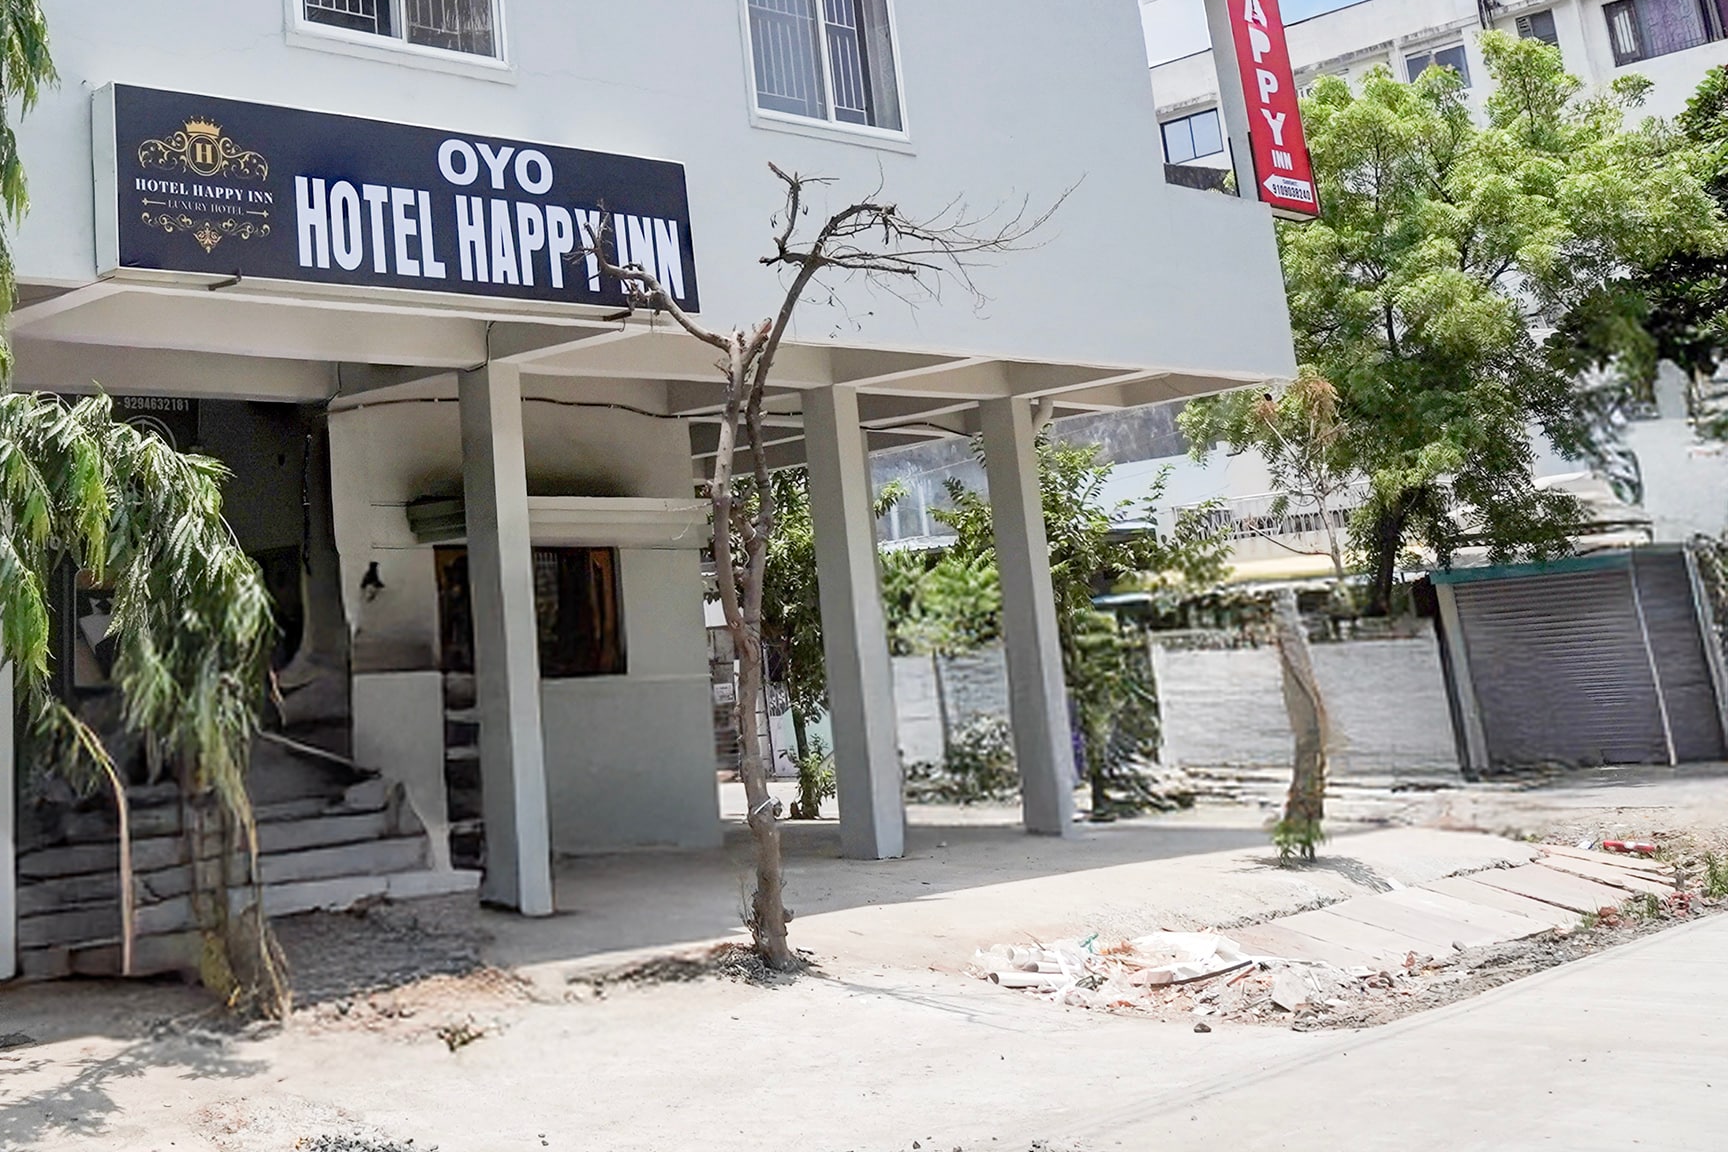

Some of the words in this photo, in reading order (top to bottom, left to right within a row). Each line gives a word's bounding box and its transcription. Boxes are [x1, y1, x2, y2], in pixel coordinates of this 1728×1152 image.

[195, 142, 214, 165] H
[1271, 149, 1294, 171] INN
[436, 138, 554, 195] OYO
[135, 178, 189, 196] HOTEL
[193, 184, 244, 202] HAPPY
[248, 190, 274, 205] INN
[167, 199, 208, 213] LUXURY
[210, 203, 245, 216] HOTEL
[295, 175, 447, 280] HOTEL
[455, 194, 601, 293] HAPPY
[613, 212, 686, 300] INN
[123, 396, 190, 412] 9294632181
